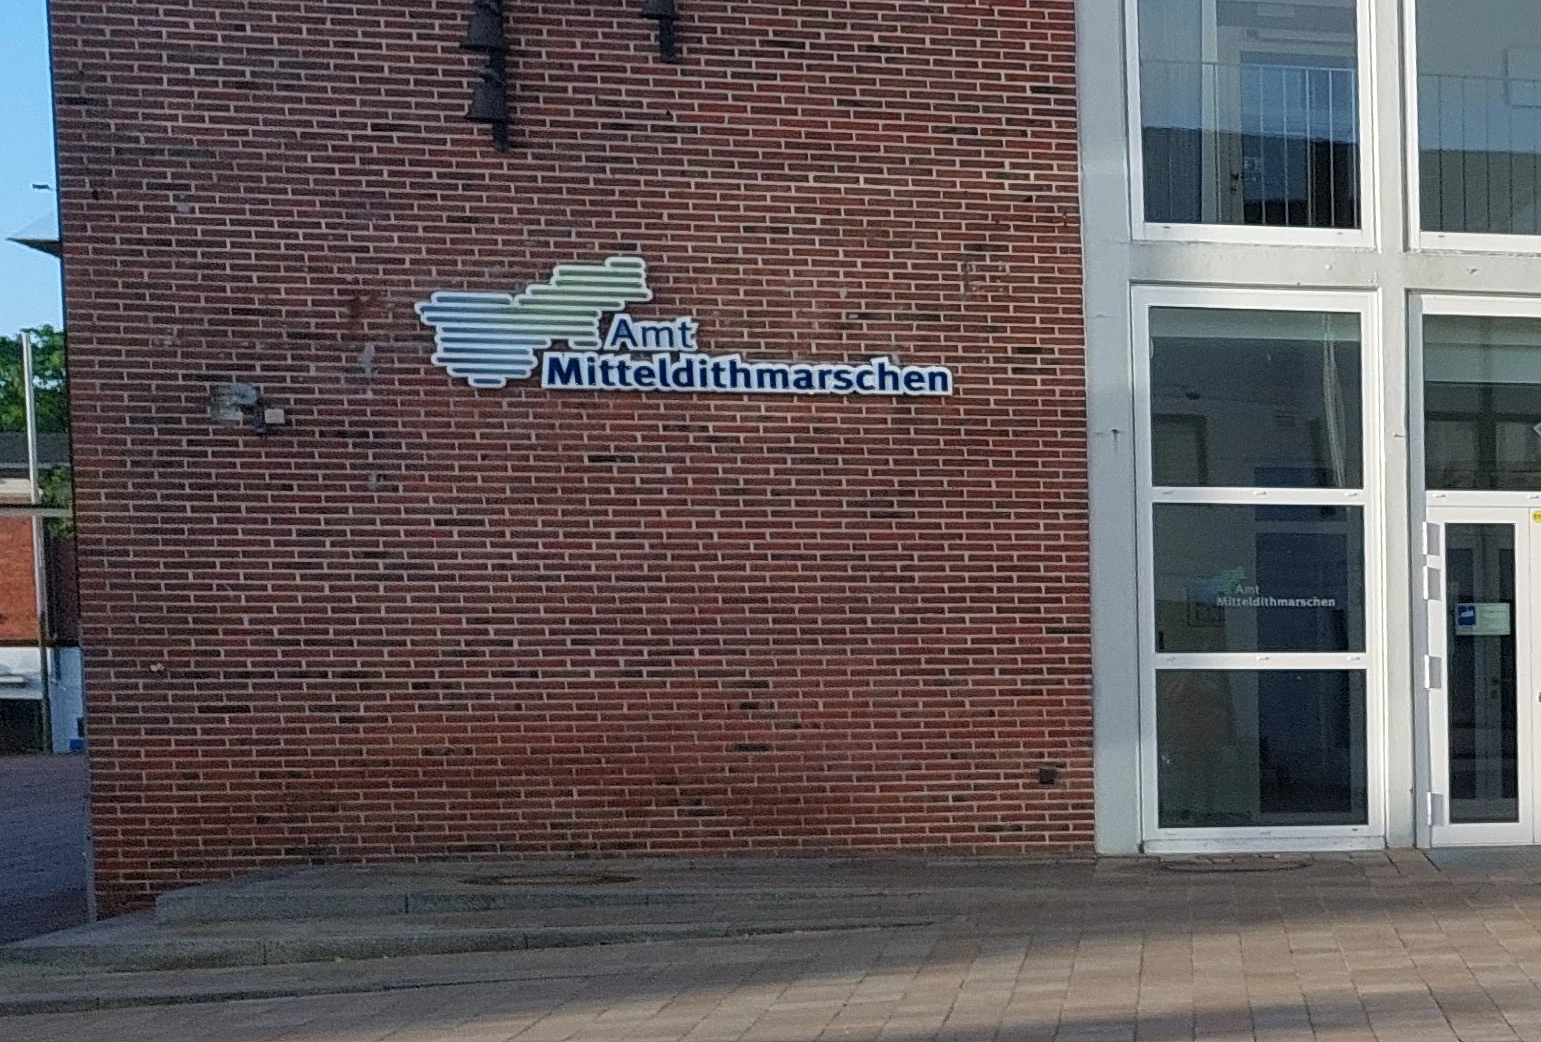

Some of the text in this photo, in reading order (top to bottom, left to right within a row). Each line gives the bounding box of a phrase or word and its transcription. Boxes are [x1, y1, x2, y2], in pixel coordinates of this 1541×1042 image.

[607, 316, 698, 350] Amt
[544, 353, 953, 395] Mitteldithmarschen
[1217, 596, 1336, 607] Mitteldithmarschen
